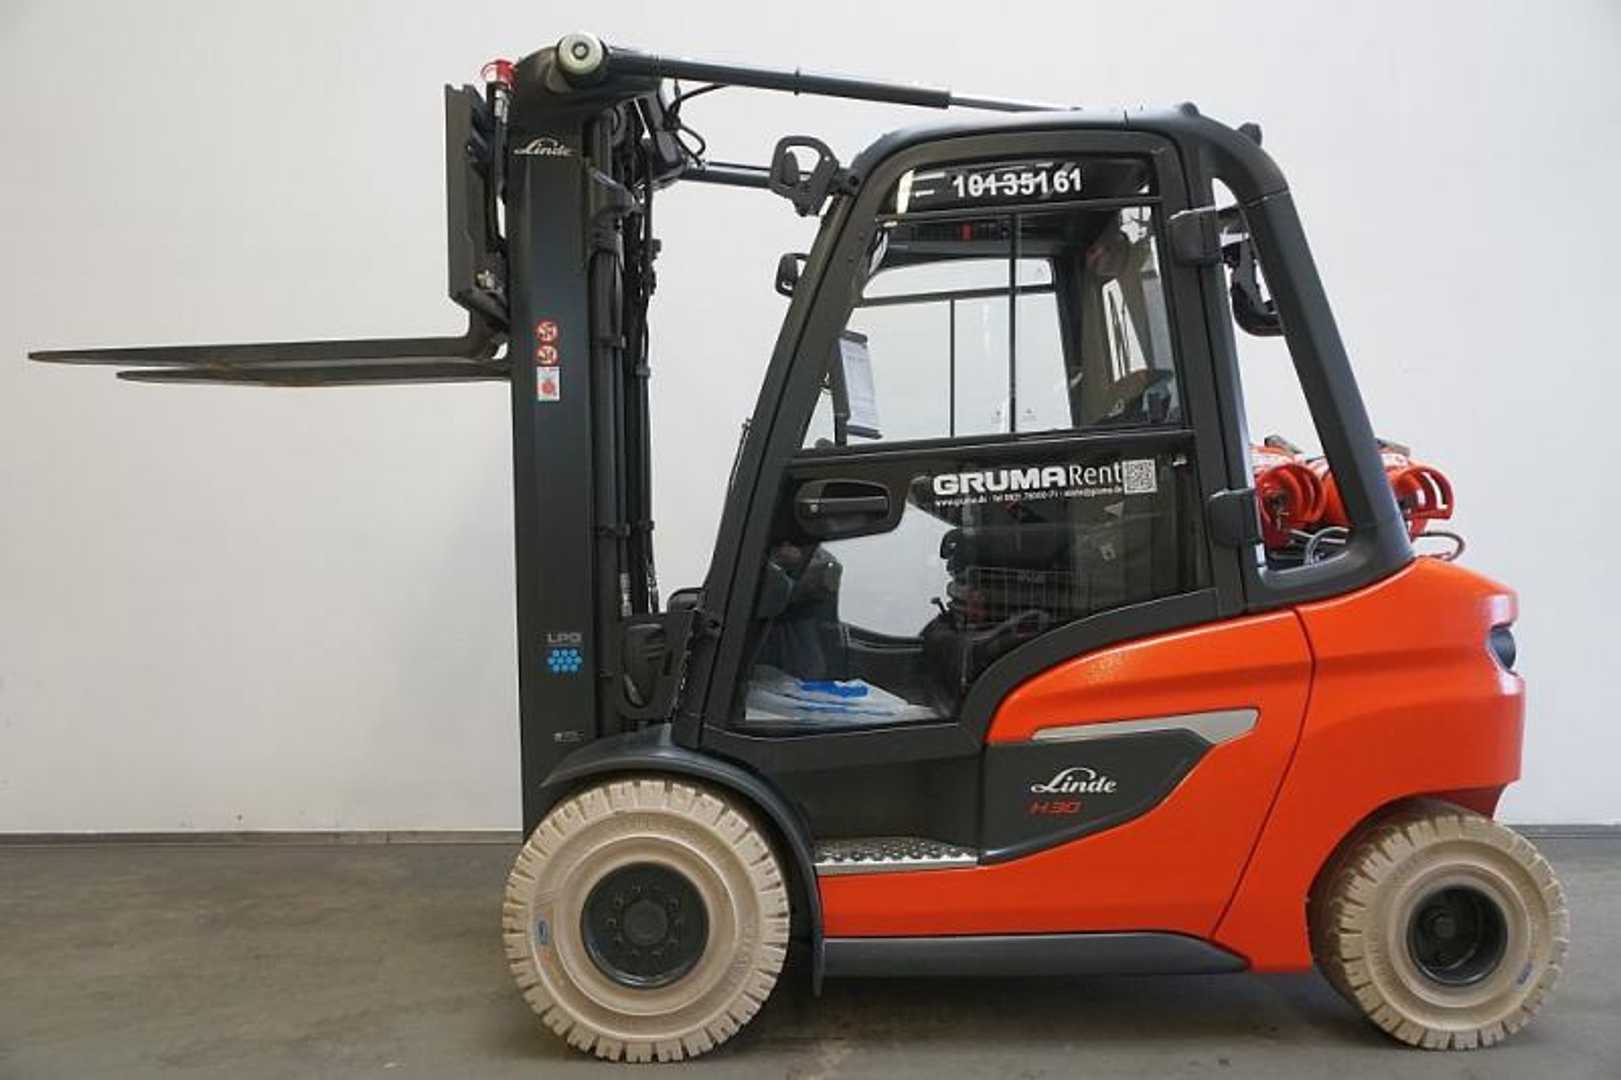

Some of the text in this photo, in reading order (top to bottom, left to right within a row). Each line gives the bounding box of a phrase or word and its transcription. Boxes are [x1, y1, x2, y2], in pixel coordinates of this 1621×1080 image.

[513, 137, 575, 157] Linde
[953, 167, 1082, 198] 10135161
[933, 466, 1067, 496] GRUMA
[1030, 767, 1117, 793] Linde
[1030, 801, 1082, 815] H30
